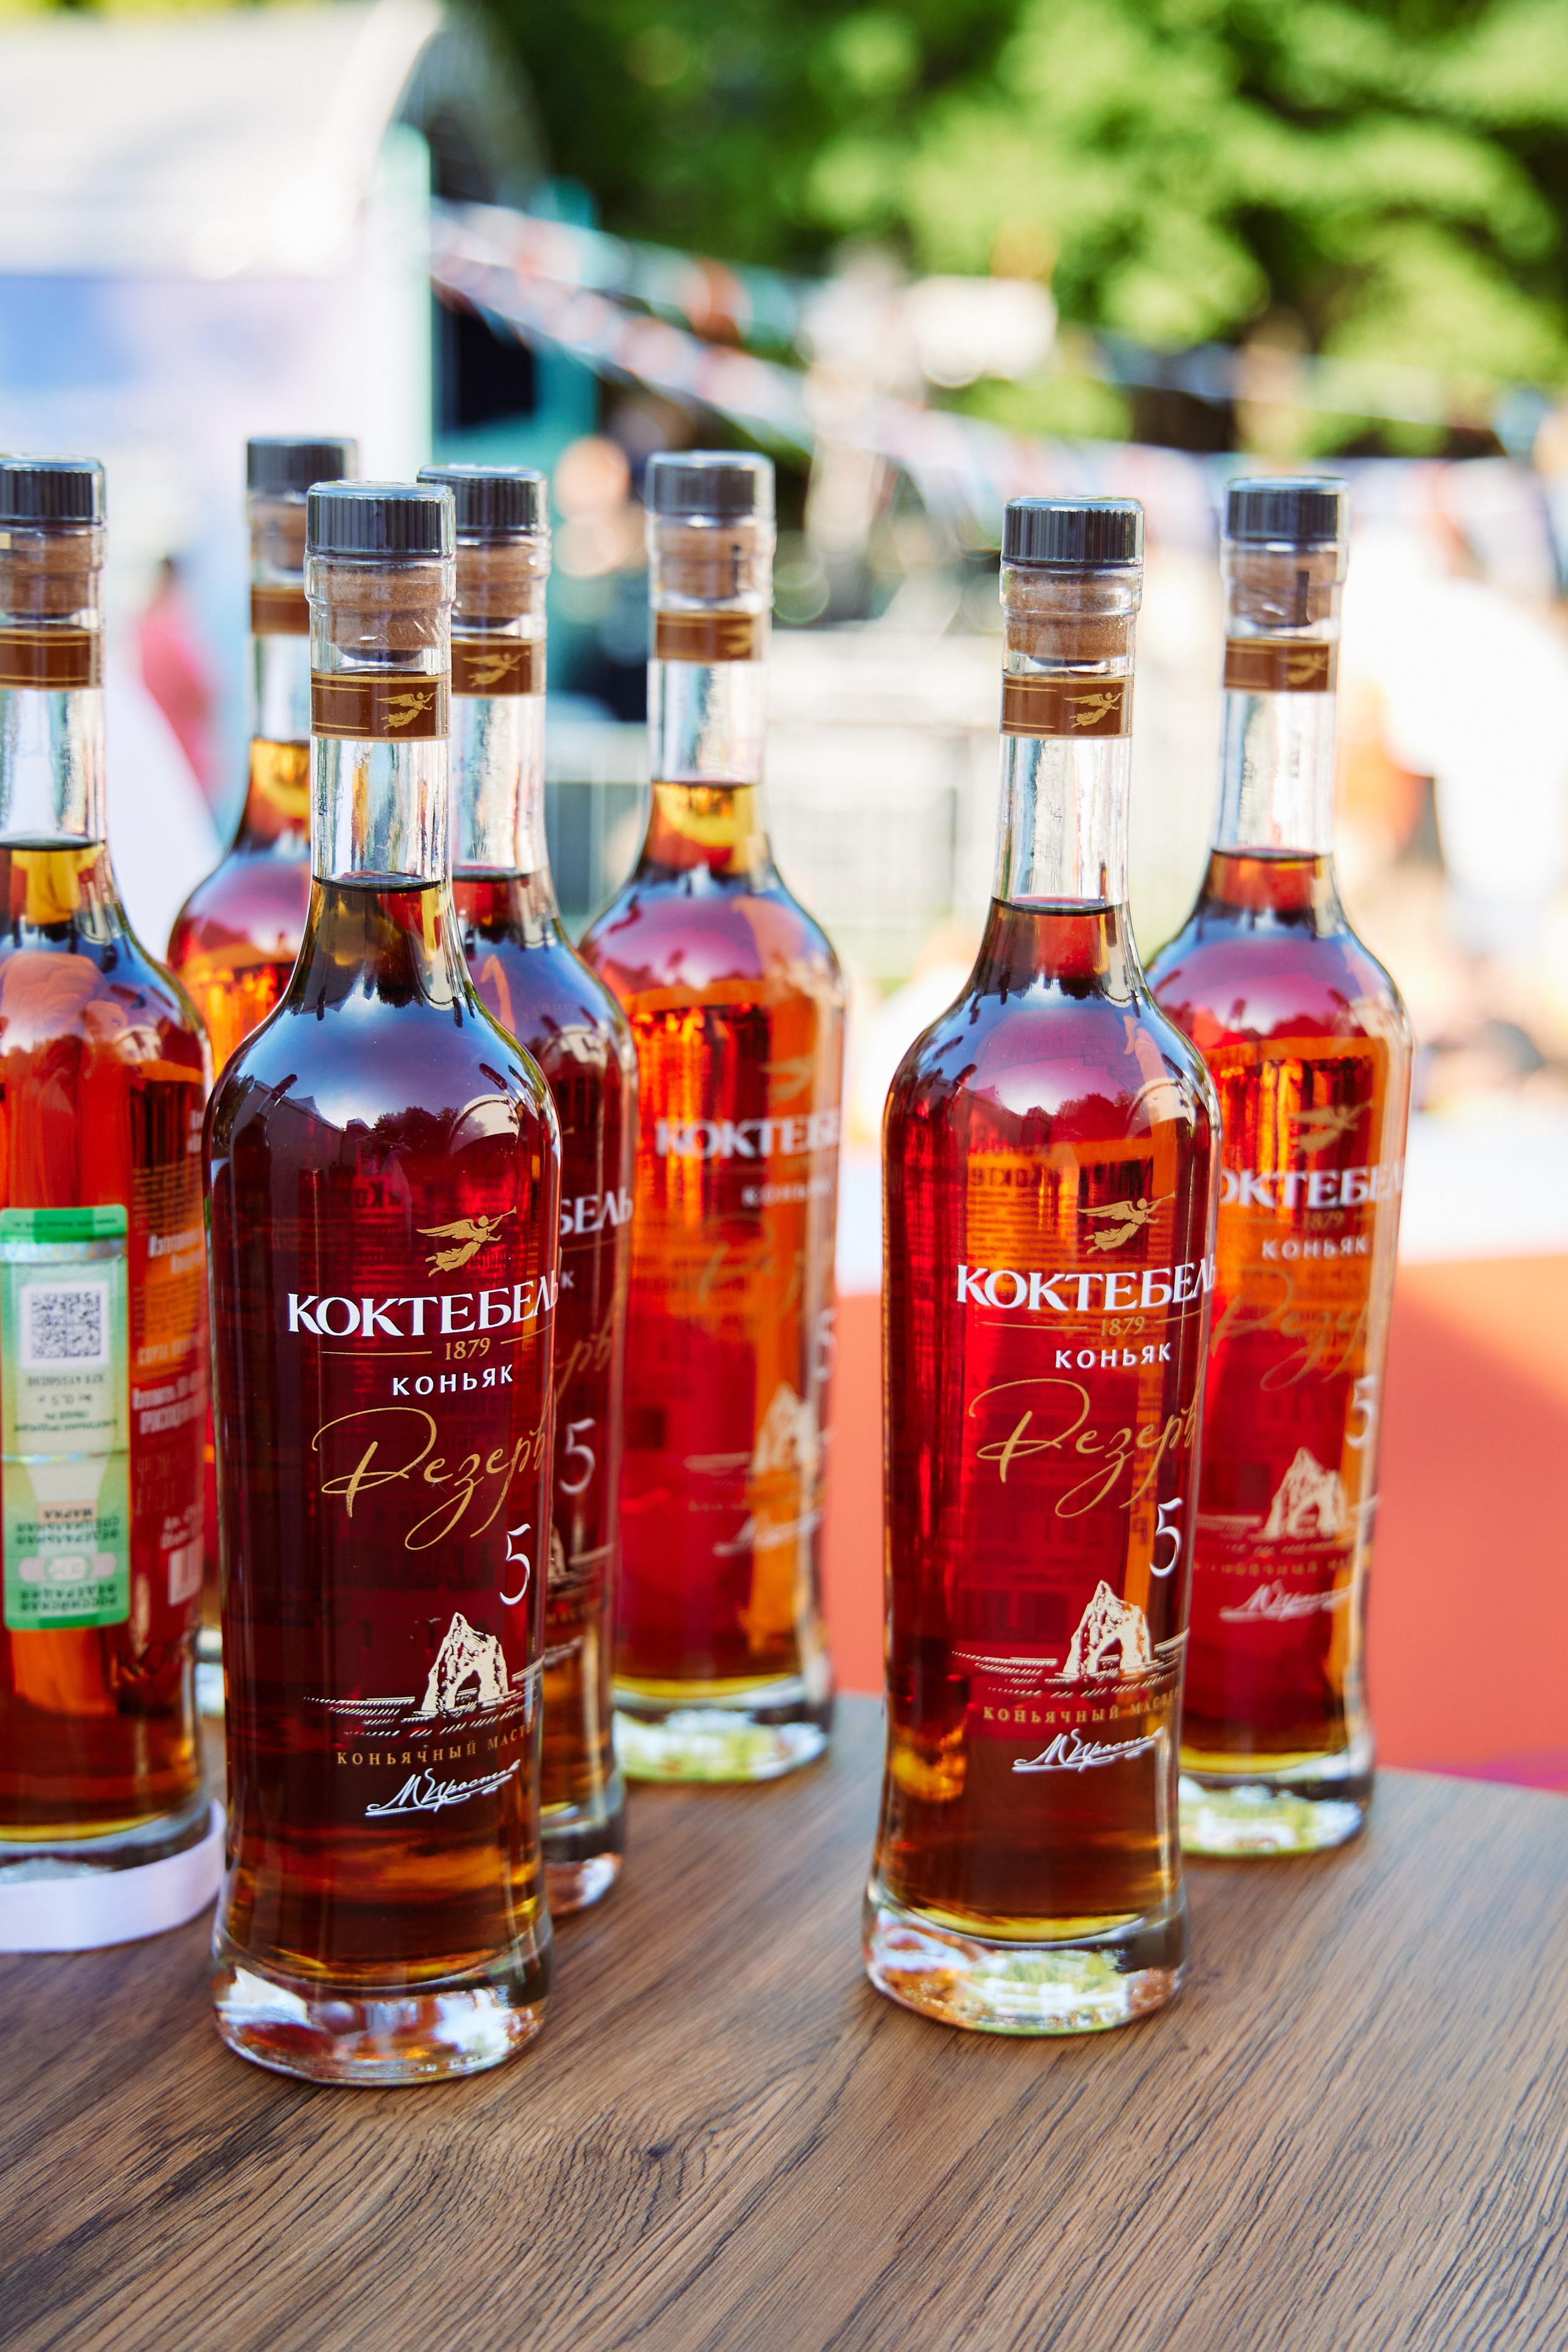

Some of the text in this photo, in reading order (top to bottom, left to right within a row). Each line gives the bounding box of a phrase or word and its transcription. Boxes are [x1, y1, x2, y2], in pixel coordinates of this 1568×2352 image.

[1261, 1234, 1370, 1261] КОНЬЯК
[956, 1253, 1216, 1311] КОКТЕБЕЛЬ
[288, 1270, 559, 1338] КОКТЕБЕЛЬ
[1100, 1316, 1145, 1338] 1879
[445, 1337, 491, 1361] 1879
[1055, 1342, 1171, 1370] КОНЬЯК
[392, 1363, 513, 1396] КОНЬЯК
[1346, 1373, 1378, 1449] 5
[559, 1417, 597, 1496] 5
[1149, 1497, 1183, 1577] 5
[500, 1523, 531, 1605] 5
[983, 1705, 1120, 1724] КОНЬЯЧНЫЙ
[337, 1740, 477, 1765] КОНЬЯЧНЫЙ
